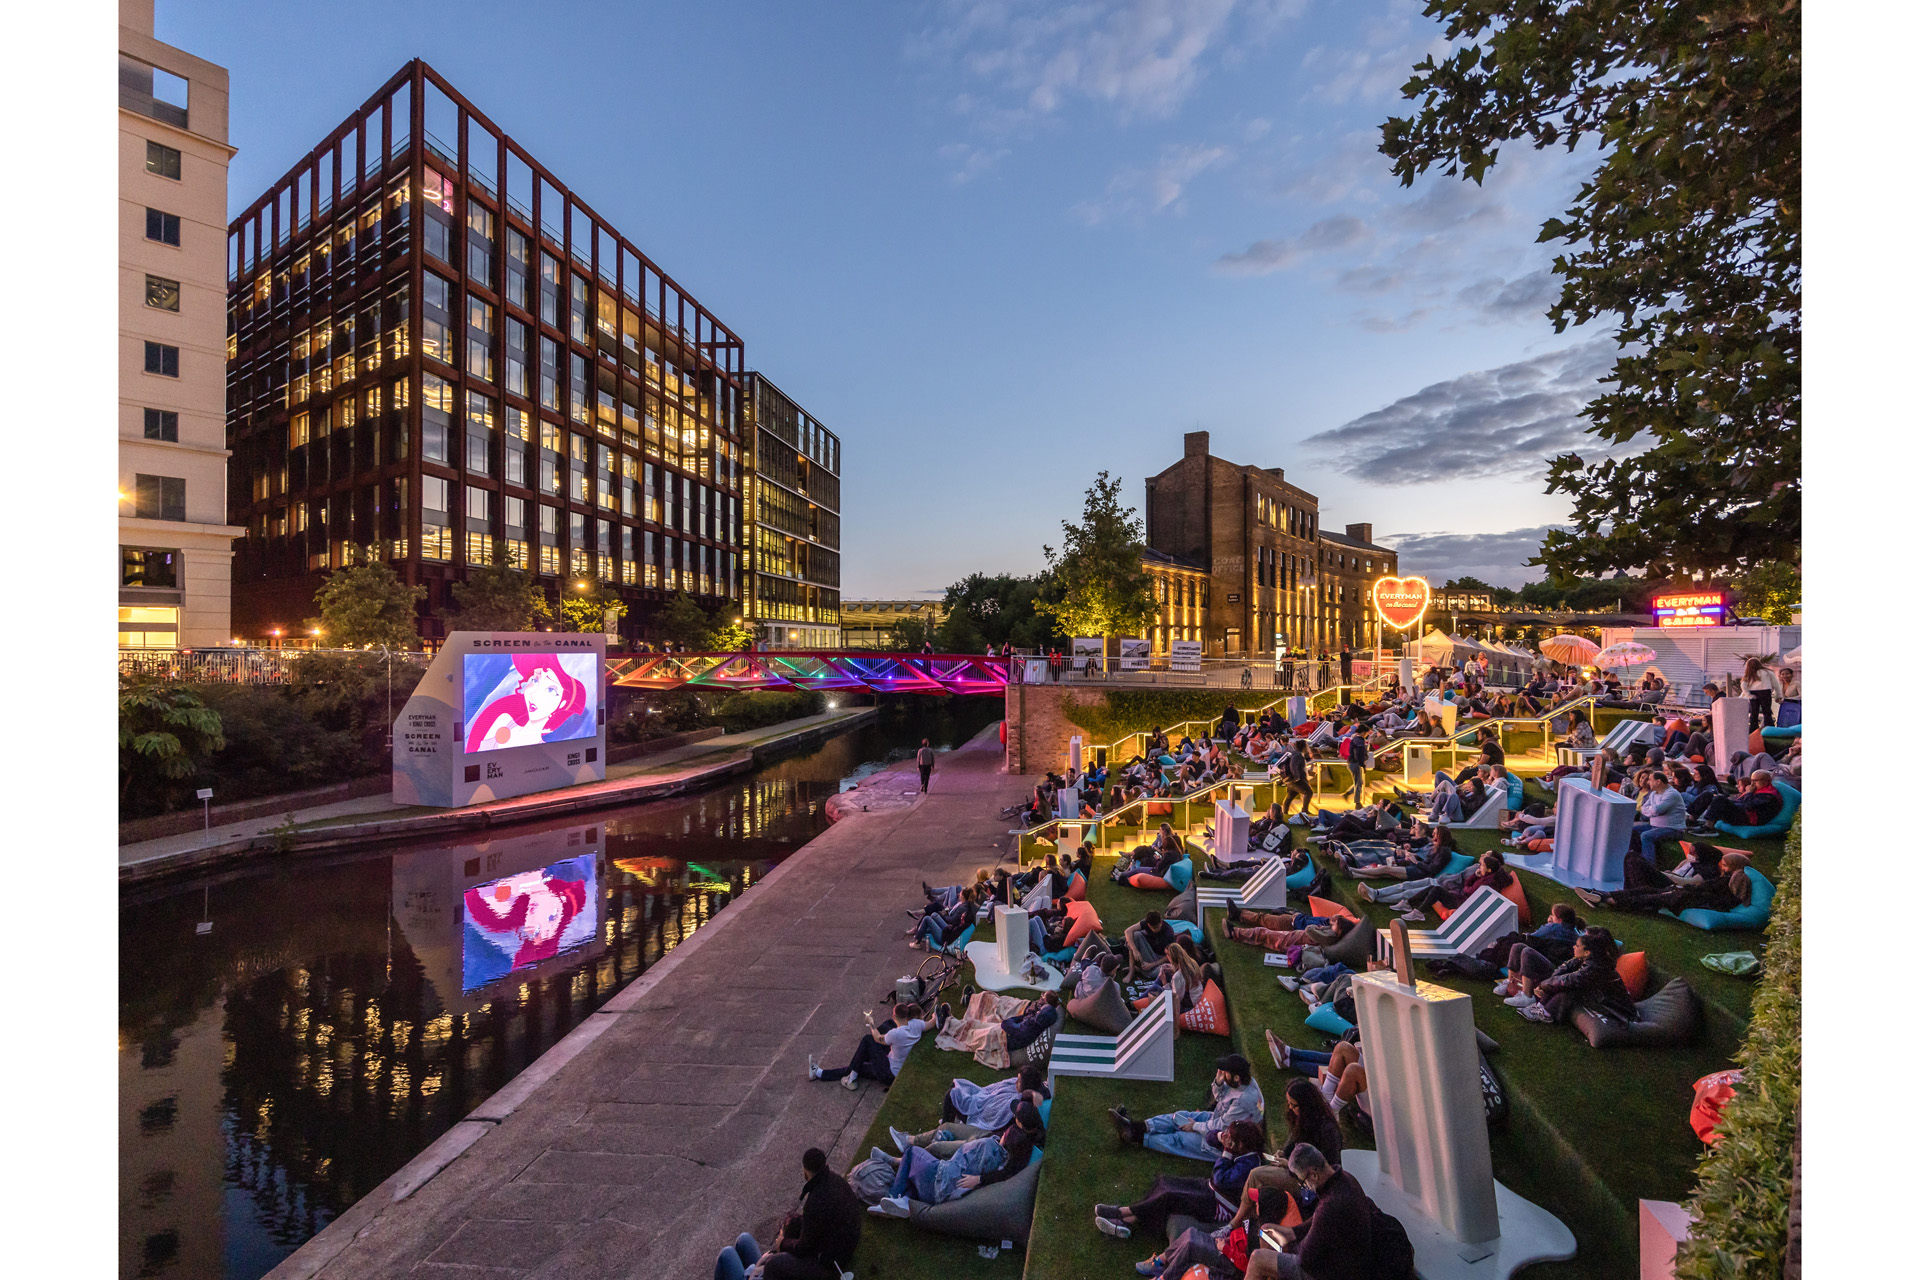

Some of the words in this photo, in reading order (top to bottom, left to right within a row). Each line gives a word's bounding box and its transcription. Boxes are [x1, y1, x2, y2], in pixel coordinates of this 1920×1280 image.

[1213, 557, 1242, 565] COAL
[1657, 596, 1721, 608] EVERYMAN
[1663, 617, 1715, 625] CANAL
